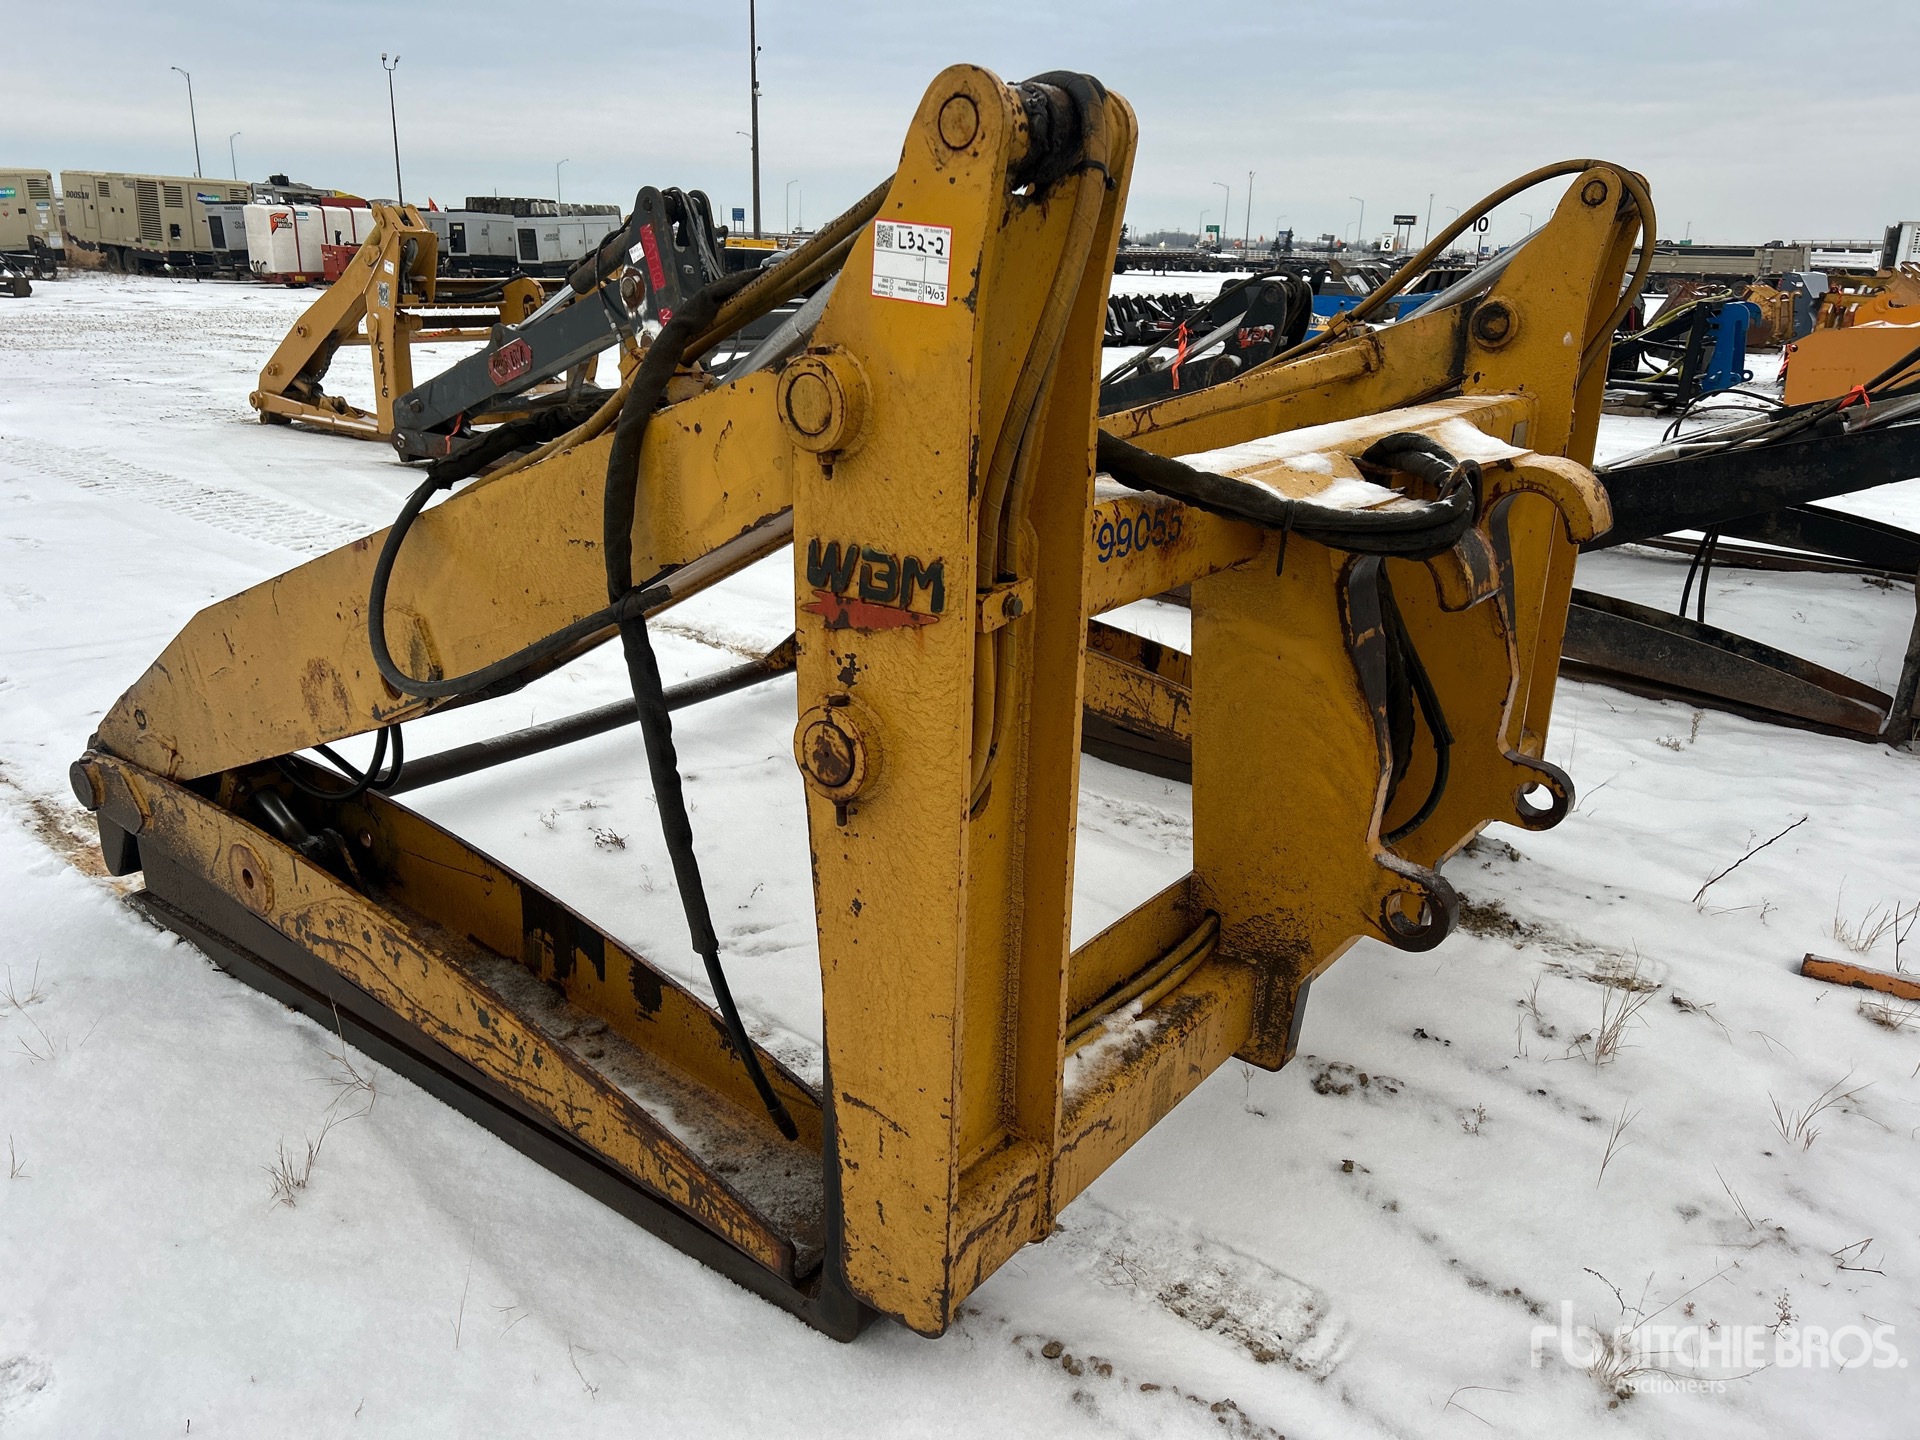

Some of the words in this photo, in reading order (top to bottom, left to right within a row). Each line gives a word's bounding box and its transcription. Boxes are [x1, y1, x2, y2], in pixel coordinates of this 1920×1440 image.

[66, 190, 89, 200] DOOSAN
[1473, 216, 1489, 232] 10
[898, 230, 944, 256] L32-2
[1383, 239, 1391, 249] 6
[925, 285, 945, 301] 12/03
[377, 341, 389, 399] CRAIG
[806, 538, 946, 613] WBM
